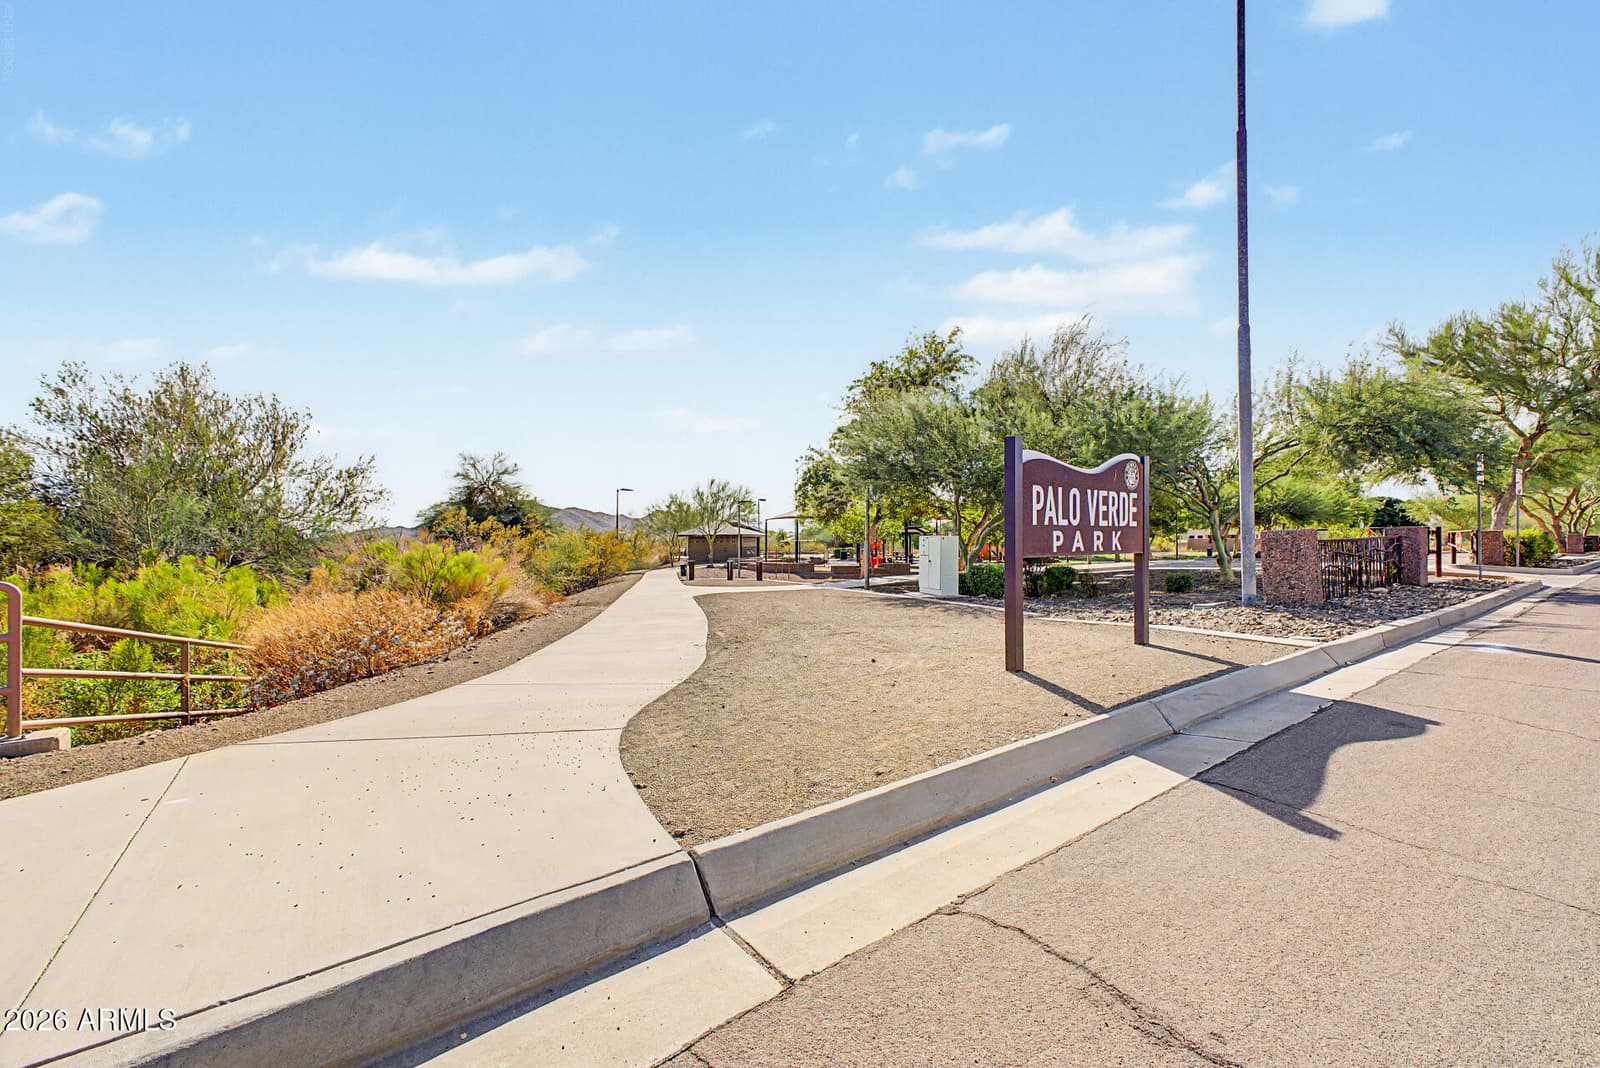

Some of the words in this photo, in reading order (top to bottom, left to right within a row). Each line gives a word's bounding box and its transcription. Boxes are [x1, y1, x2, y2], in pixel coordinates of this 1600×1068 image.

[1032, 484, 1080, 526] PALO
[1087, 488, 1138, 527] VERDE
[1052, 530, 1122, 553] PARK
